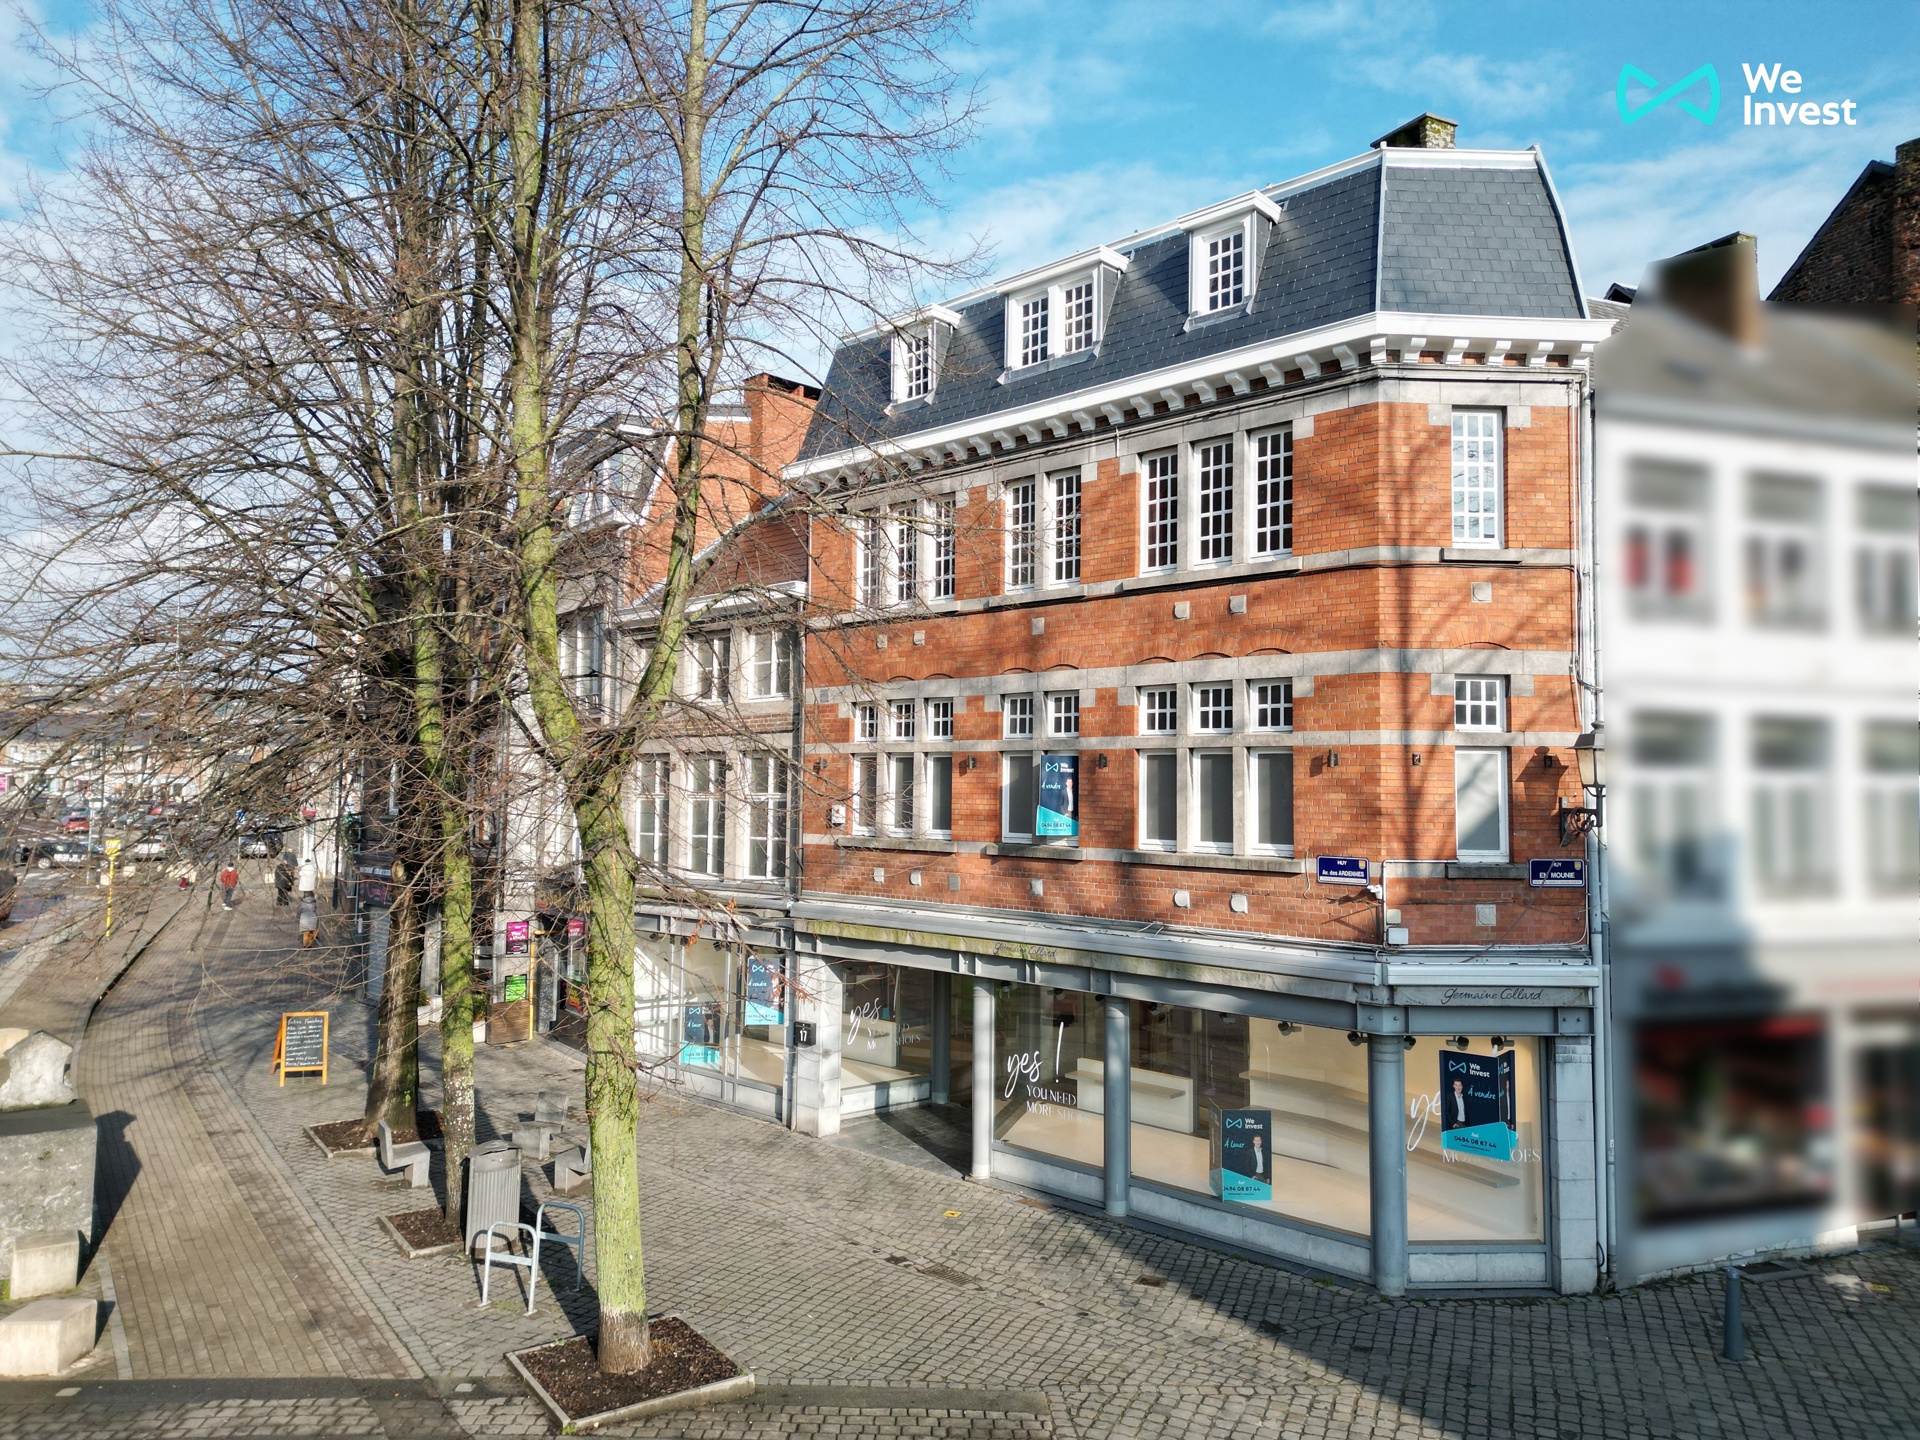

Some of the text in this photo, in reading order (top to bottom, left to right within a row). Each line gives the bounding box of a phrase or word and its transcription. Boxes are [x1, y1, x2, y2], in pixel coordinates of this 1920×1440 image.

[1338, 870, 1365, 878] ARDENNES
[1550, 871, 1576, 879] MOUNIE
[1441, 987, 1544, 1005] Germaine Collard
[846, 997, 882, 1046] yes
[800, 1029, 807, 1042] 17
[1469, 1062, 1481, 1070] We
[1004, 1050, 1044, 1099] yes
[1469, 1069, 1491, 1078] Invest
[1026, 1084, 1077, 1106] YOU NEED
[1474, 1090, 1497, 1100] vendre
[1026, 1100, 1054, 1117] MORE
[1406, 1089, 1442, 1152] ye
[1453, 1135, 1470, 1144] 0494
[1470, 1138, 1480, 1146] 08
